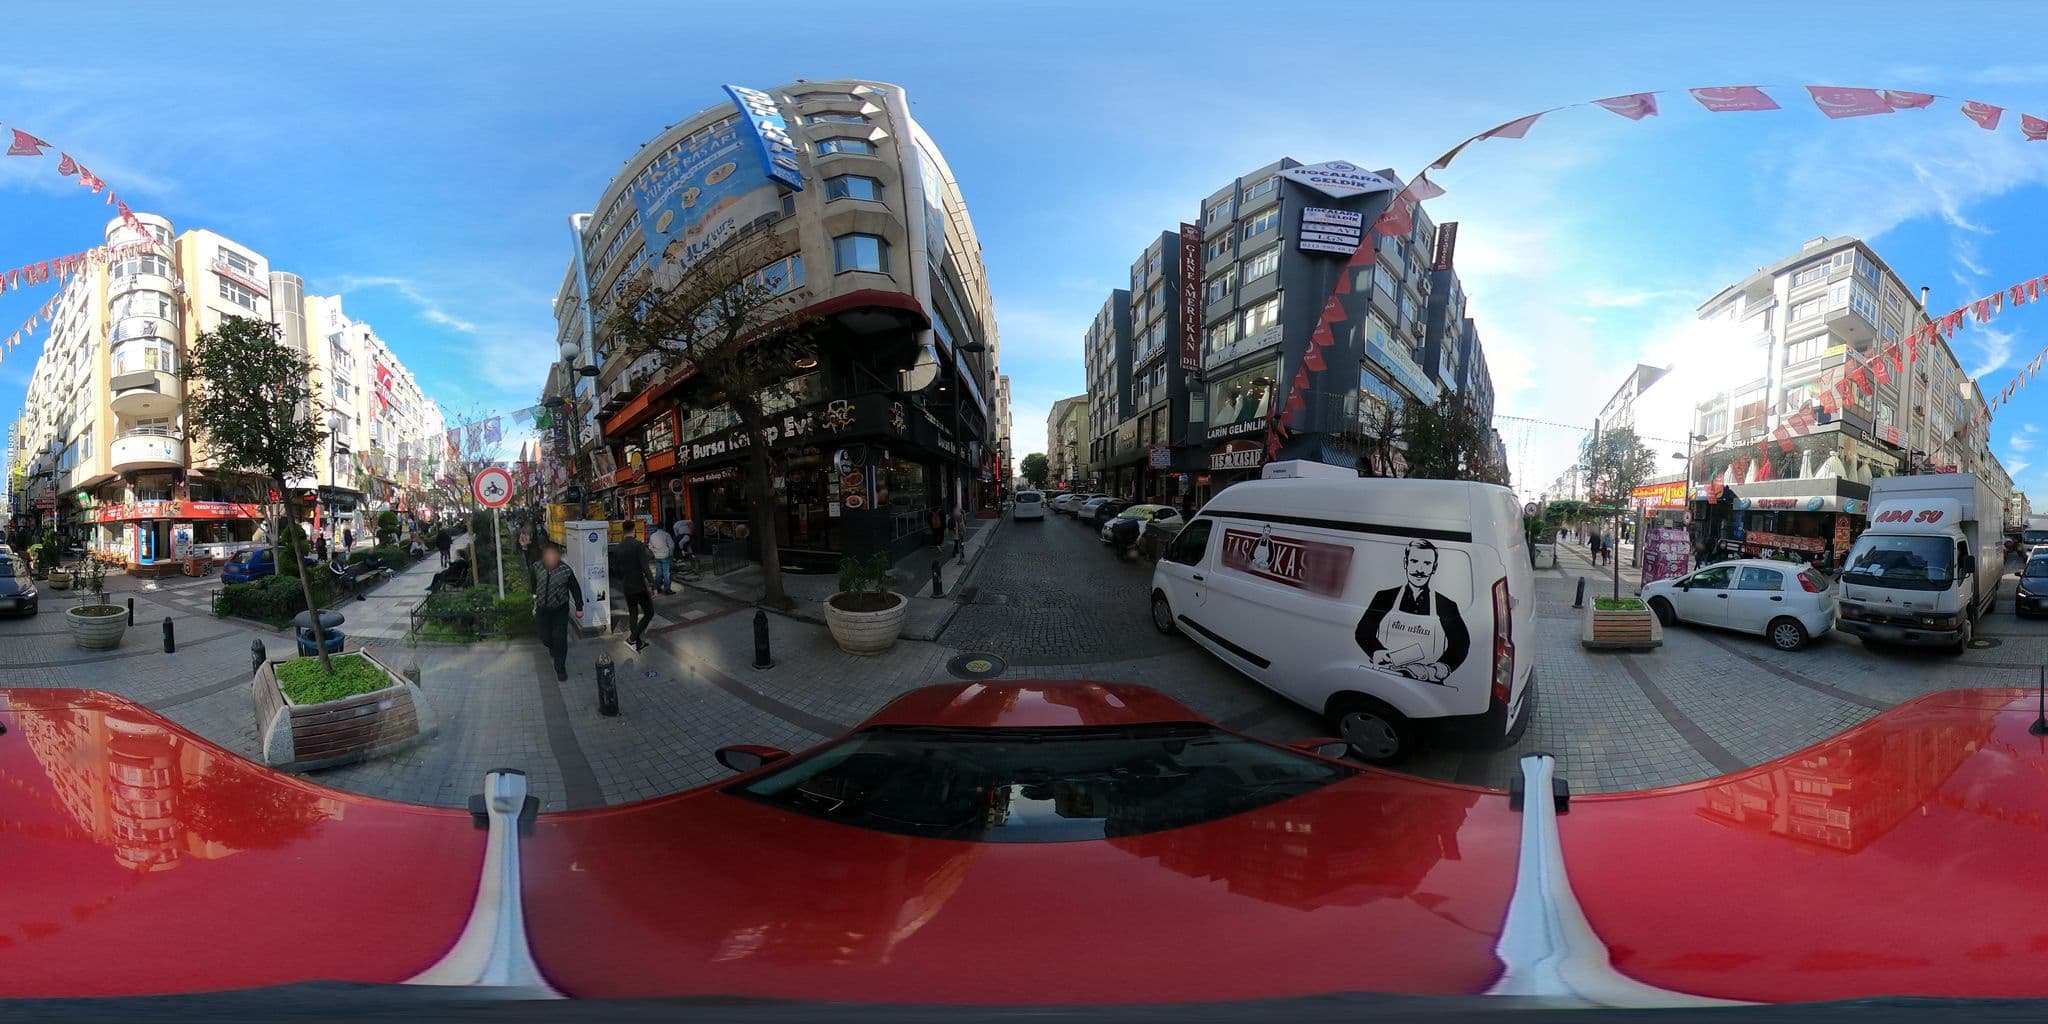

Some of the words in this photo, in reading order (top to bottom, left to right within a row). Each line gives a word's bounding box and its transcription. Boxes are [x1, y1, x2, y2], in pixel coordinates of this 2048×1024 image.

[1294, 169, 1382, 183] HOCALARA
[1310, 177, 1367, 188] GELDİK
[1306, 207, 1360, 217] HOCALARA
[1185, 244, 1195, 280] GİRNE
[1185, 282, 1196, 351] AMERİKAN
[1183, 357, 1198, 367] DİL
[692, 440, 726, 460] Bursa
[728, 426, 779, 451] Kep
[783, 411, 813, 438] Evi
[1232, 451, 1261, 467] KASAP
[1875, 509, 1914, 524] ADA
[1915, 509, 1944, 524] SU
